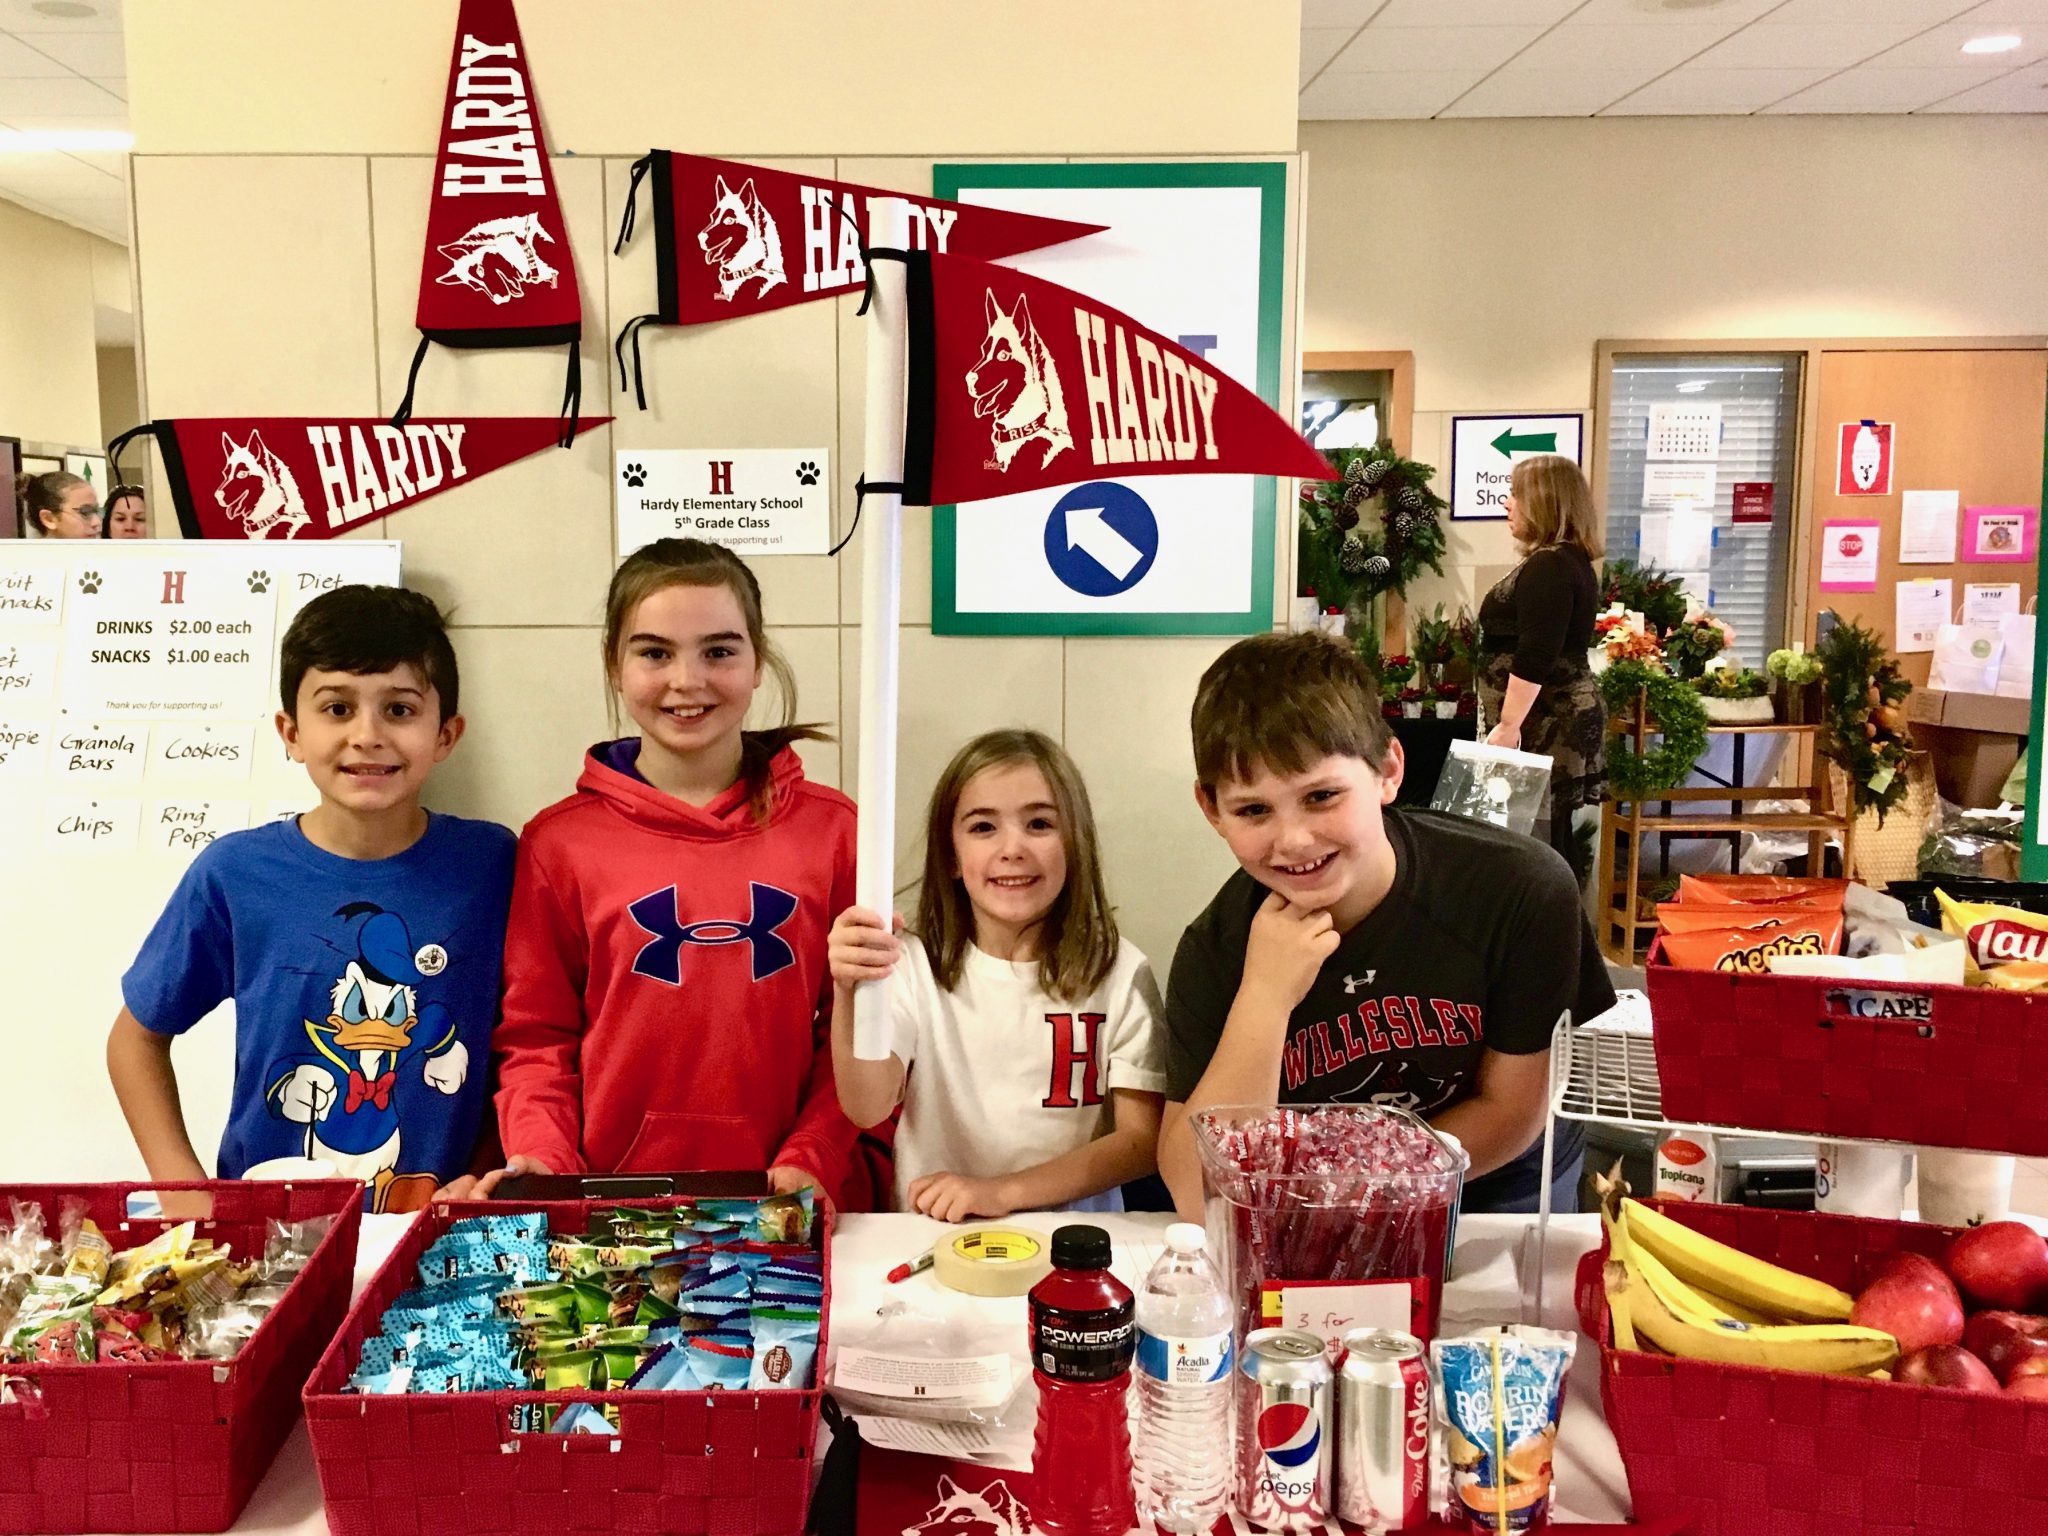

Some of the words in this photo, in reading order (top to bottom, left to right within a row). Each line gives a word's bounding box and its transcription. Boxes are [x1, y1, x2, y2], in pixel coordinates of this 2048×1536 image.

[442, 34, 546, 196] HARDY
[801, 185, 958, 293] HADY
[1074, 307, 1219, 465] HARDY
[1008, 421, 1042, 441] RISE
[306, 424, 468, 529] HARDY
[708, 461, 734, 495] H
[1476, 471, 1512, 484] More
[640, 499, 679, 512] Hardy
[683, 498, 757, 512] Elementary
[760, 497, 803, 509] School
[675, 516, 692, 529] 5th
[695, 517, 734, 529] Grade
[738, 516, 770, 529] Class
[723, 536, 768, 546] supporting
[769, 535, 783, 544] us!
[1840, 540, 1862, 551] STOP
[160, 571, 188, 604] H
[297, 572, 344, 591] Diet
[0, 595, 53, 612] nacks
[96, 620, 153, 635] DRINKS
[168, 620, 212, 636] $2.00
[216, 620, 252, 635] each
[90, 649, 151, 664] SNACKS
[167, 648, 210, 664] $1.00
[213, 649, 250, 664] each
[105, 701, 130, 710] Thank
[131, 702, 146, 712] you
[148, 701, 162, 711] for
[163, 701, 207, 711] supporting
[208, 701, 223, 711] us!
[60, 733, 135, 754] Granola
[164, 737, 240, 762] Cookies
[69, 755, 114, 771] Bars
[57, 815, 114, 840] Chips
[160, 806, 207, 829] Ring
[168, 828, 217, 849] Pops
[1857, 997, 1932, 1019] CAPE
[1041, 1012, 1106, 1108] H
[1659, 1167, 1705, 1185] Tropicana
[1297, 1313, 1309, 1329] 3
[1322, 1312, 1355, 1329] for
[1176, 1355, 1210, 1367] Acadia
[1405, 1380, 1429, 1461] Coke
[1261, 1477, 1316, 1499] pepsi
[1410, 1461, 1424, 1499] Diet
